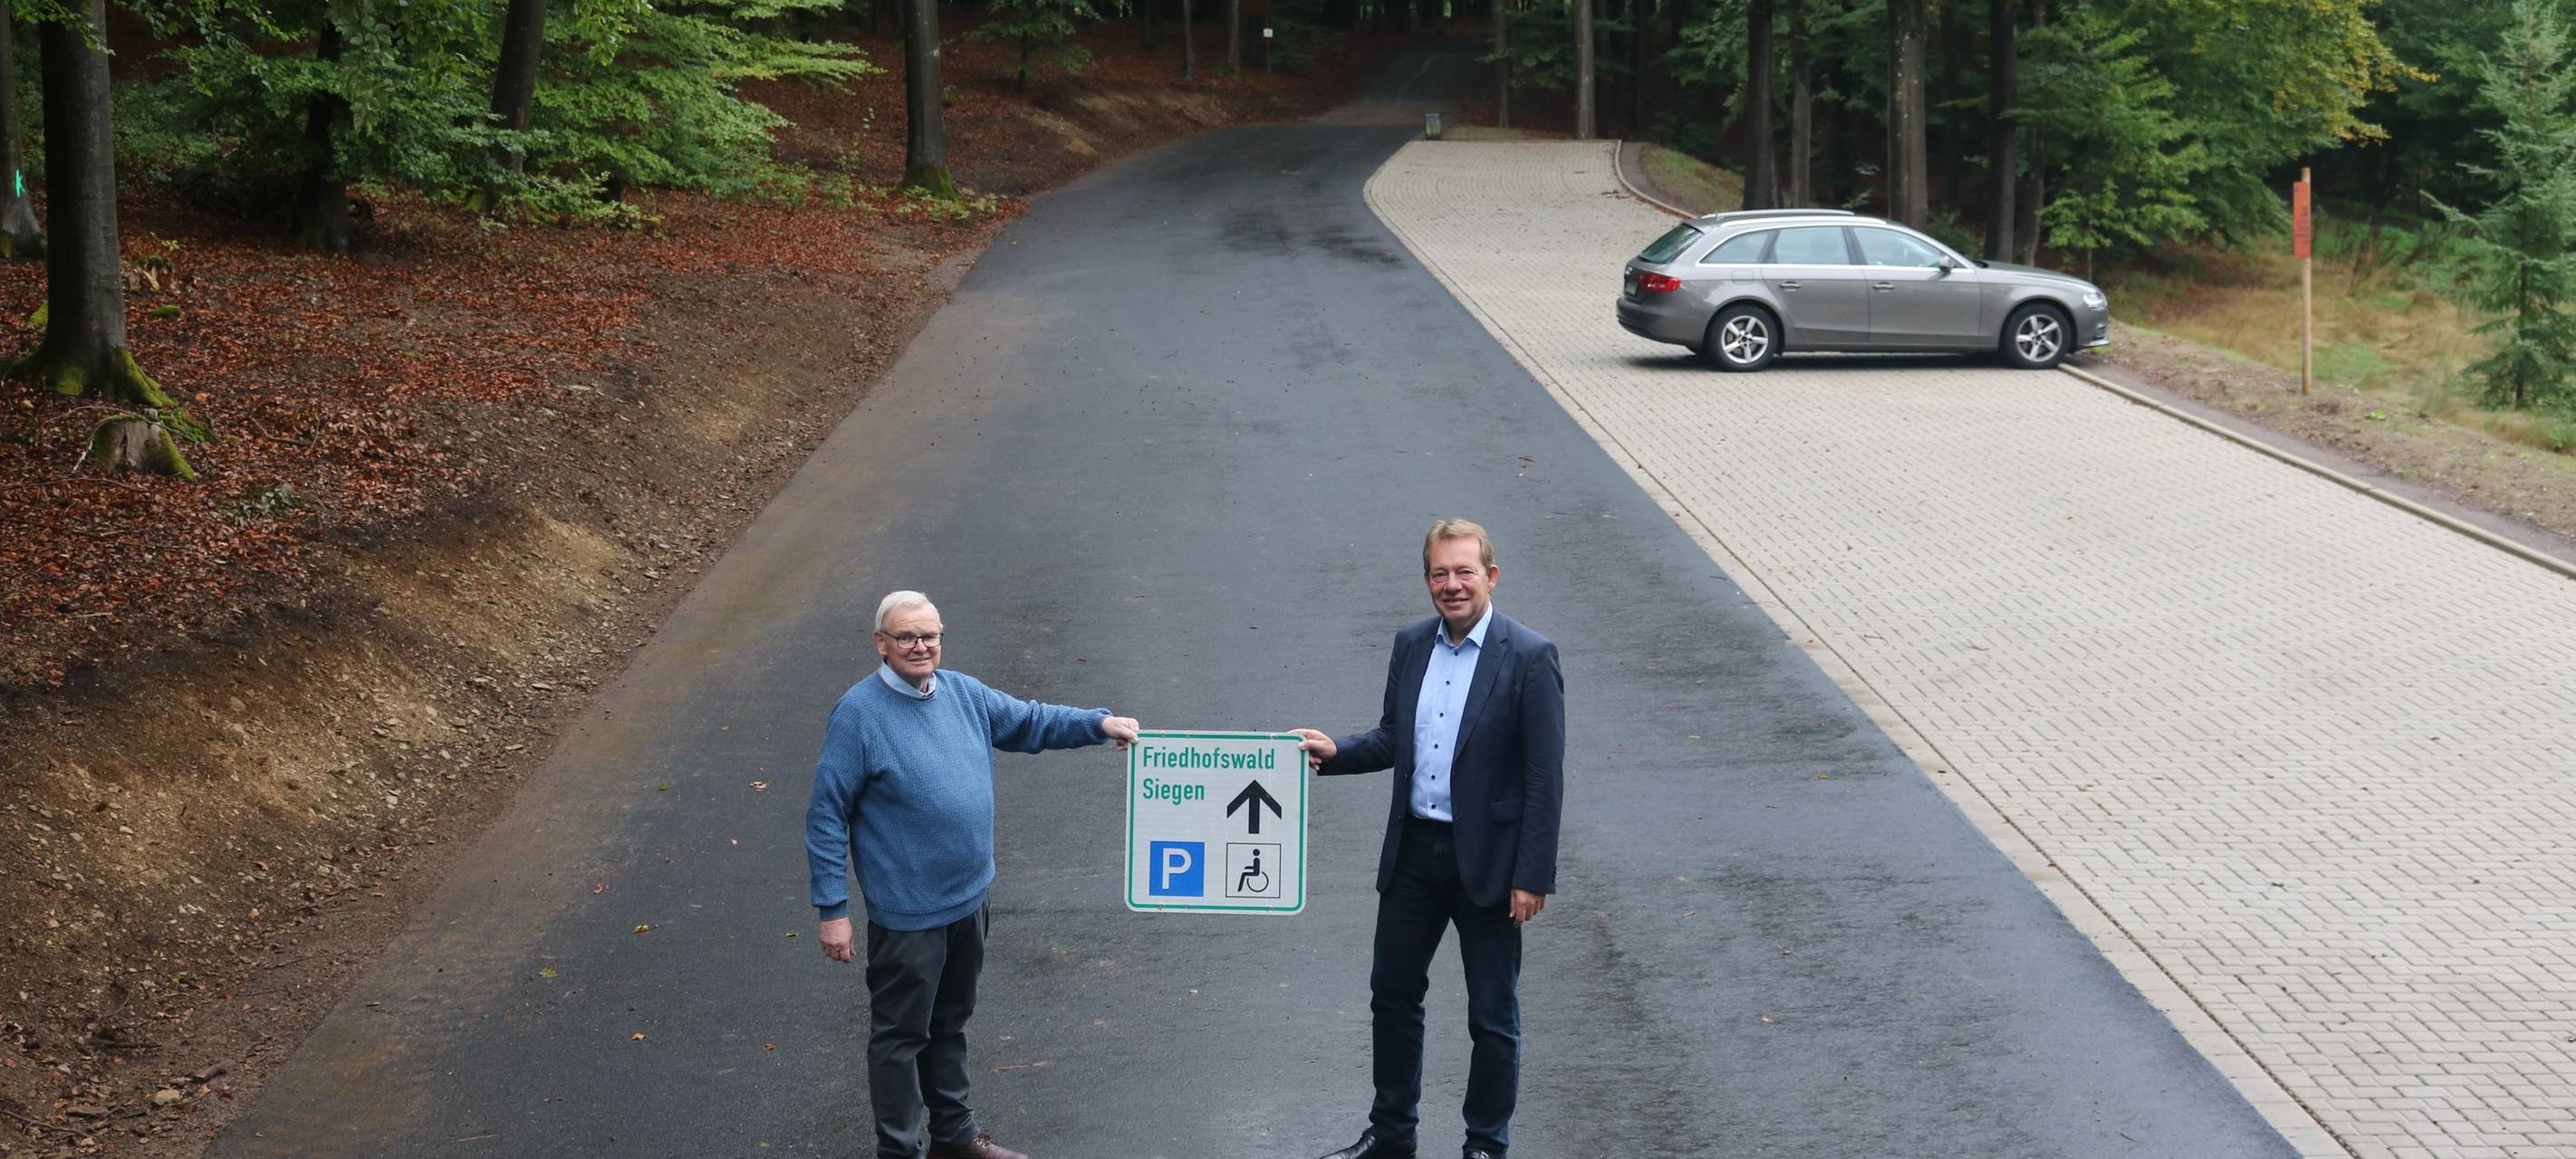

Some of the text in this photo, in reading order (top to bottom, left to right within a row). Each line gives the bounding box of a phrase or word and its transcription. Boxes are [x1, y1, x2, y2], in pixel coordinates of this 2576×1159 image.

[1143, 746, 1275, 770] Friedhofswald
[1143, 778, 1205, 805] Siegen
[1162, 848, 1192, 890] P
